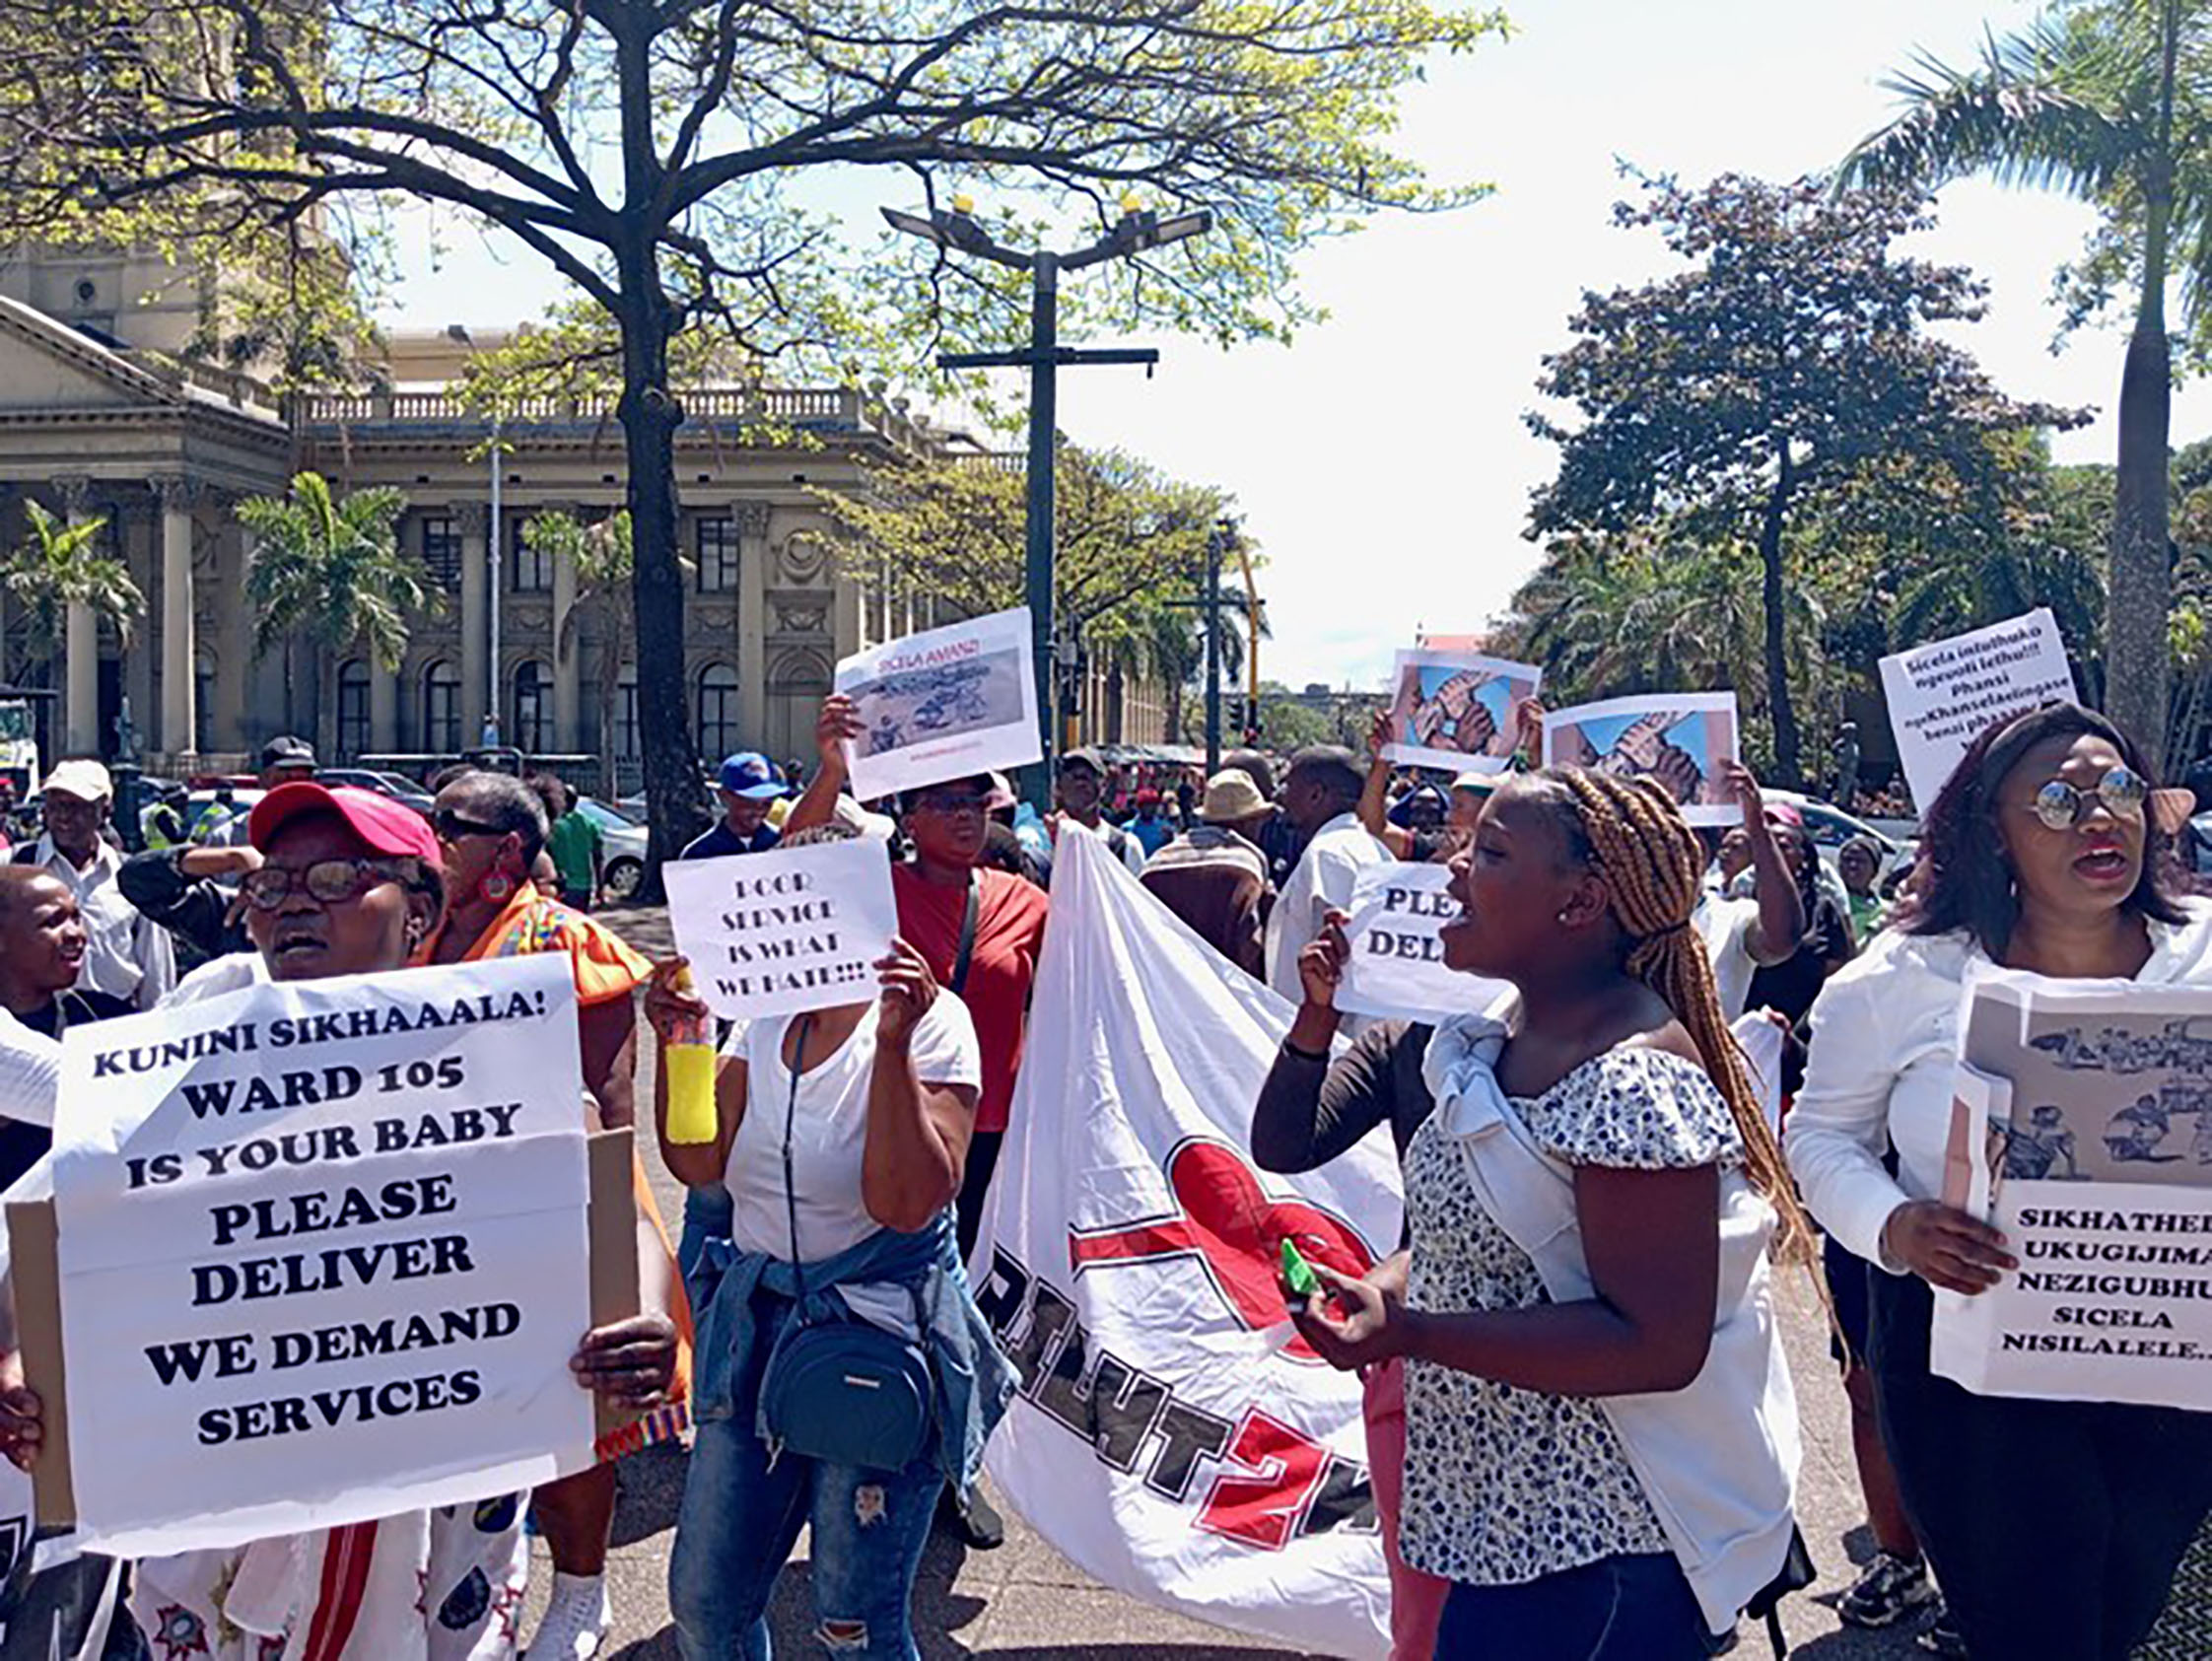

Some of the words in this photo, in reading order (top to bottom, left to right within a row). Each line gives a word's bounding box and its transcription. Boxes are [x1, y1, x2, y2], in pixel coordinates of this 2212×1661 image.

[1951, 670, 2010, 697] Phansi
[735, 872, 813, 899] POOR
[1383, 887, 1465, 919] PLE
[722, 900, 837, 931] SERVICE
[728, 944, 753, 964] IS
[758, 933, 840, 958] WHAT
[716, 977, 755, 997] WE
[762, 960, 865, 993] HATE!!!
[93, 1021, 257, 1077] KUNINI
[269, 990, 546, 1048] SIKHAAALA!
[181, 1063, 362, 1119] WARD
[377, 1055, 465, 1092] 105
[126, 1154, 181, 1189] IS
[194, 1124, 361, 1176] YOUR
[374, 1102, 522, 1154] BABY
[209, 1173, 457, 1246] PLEASE
[191, 1233, 474, 1308] DELIVER
[144, 1333, 257, 1385] WE
[270, 1301, 521, 1370] DEMAND
[2052, 1306, 2174, 1330] SICELA
[197, 1369, 481, 1445] SERVICES
